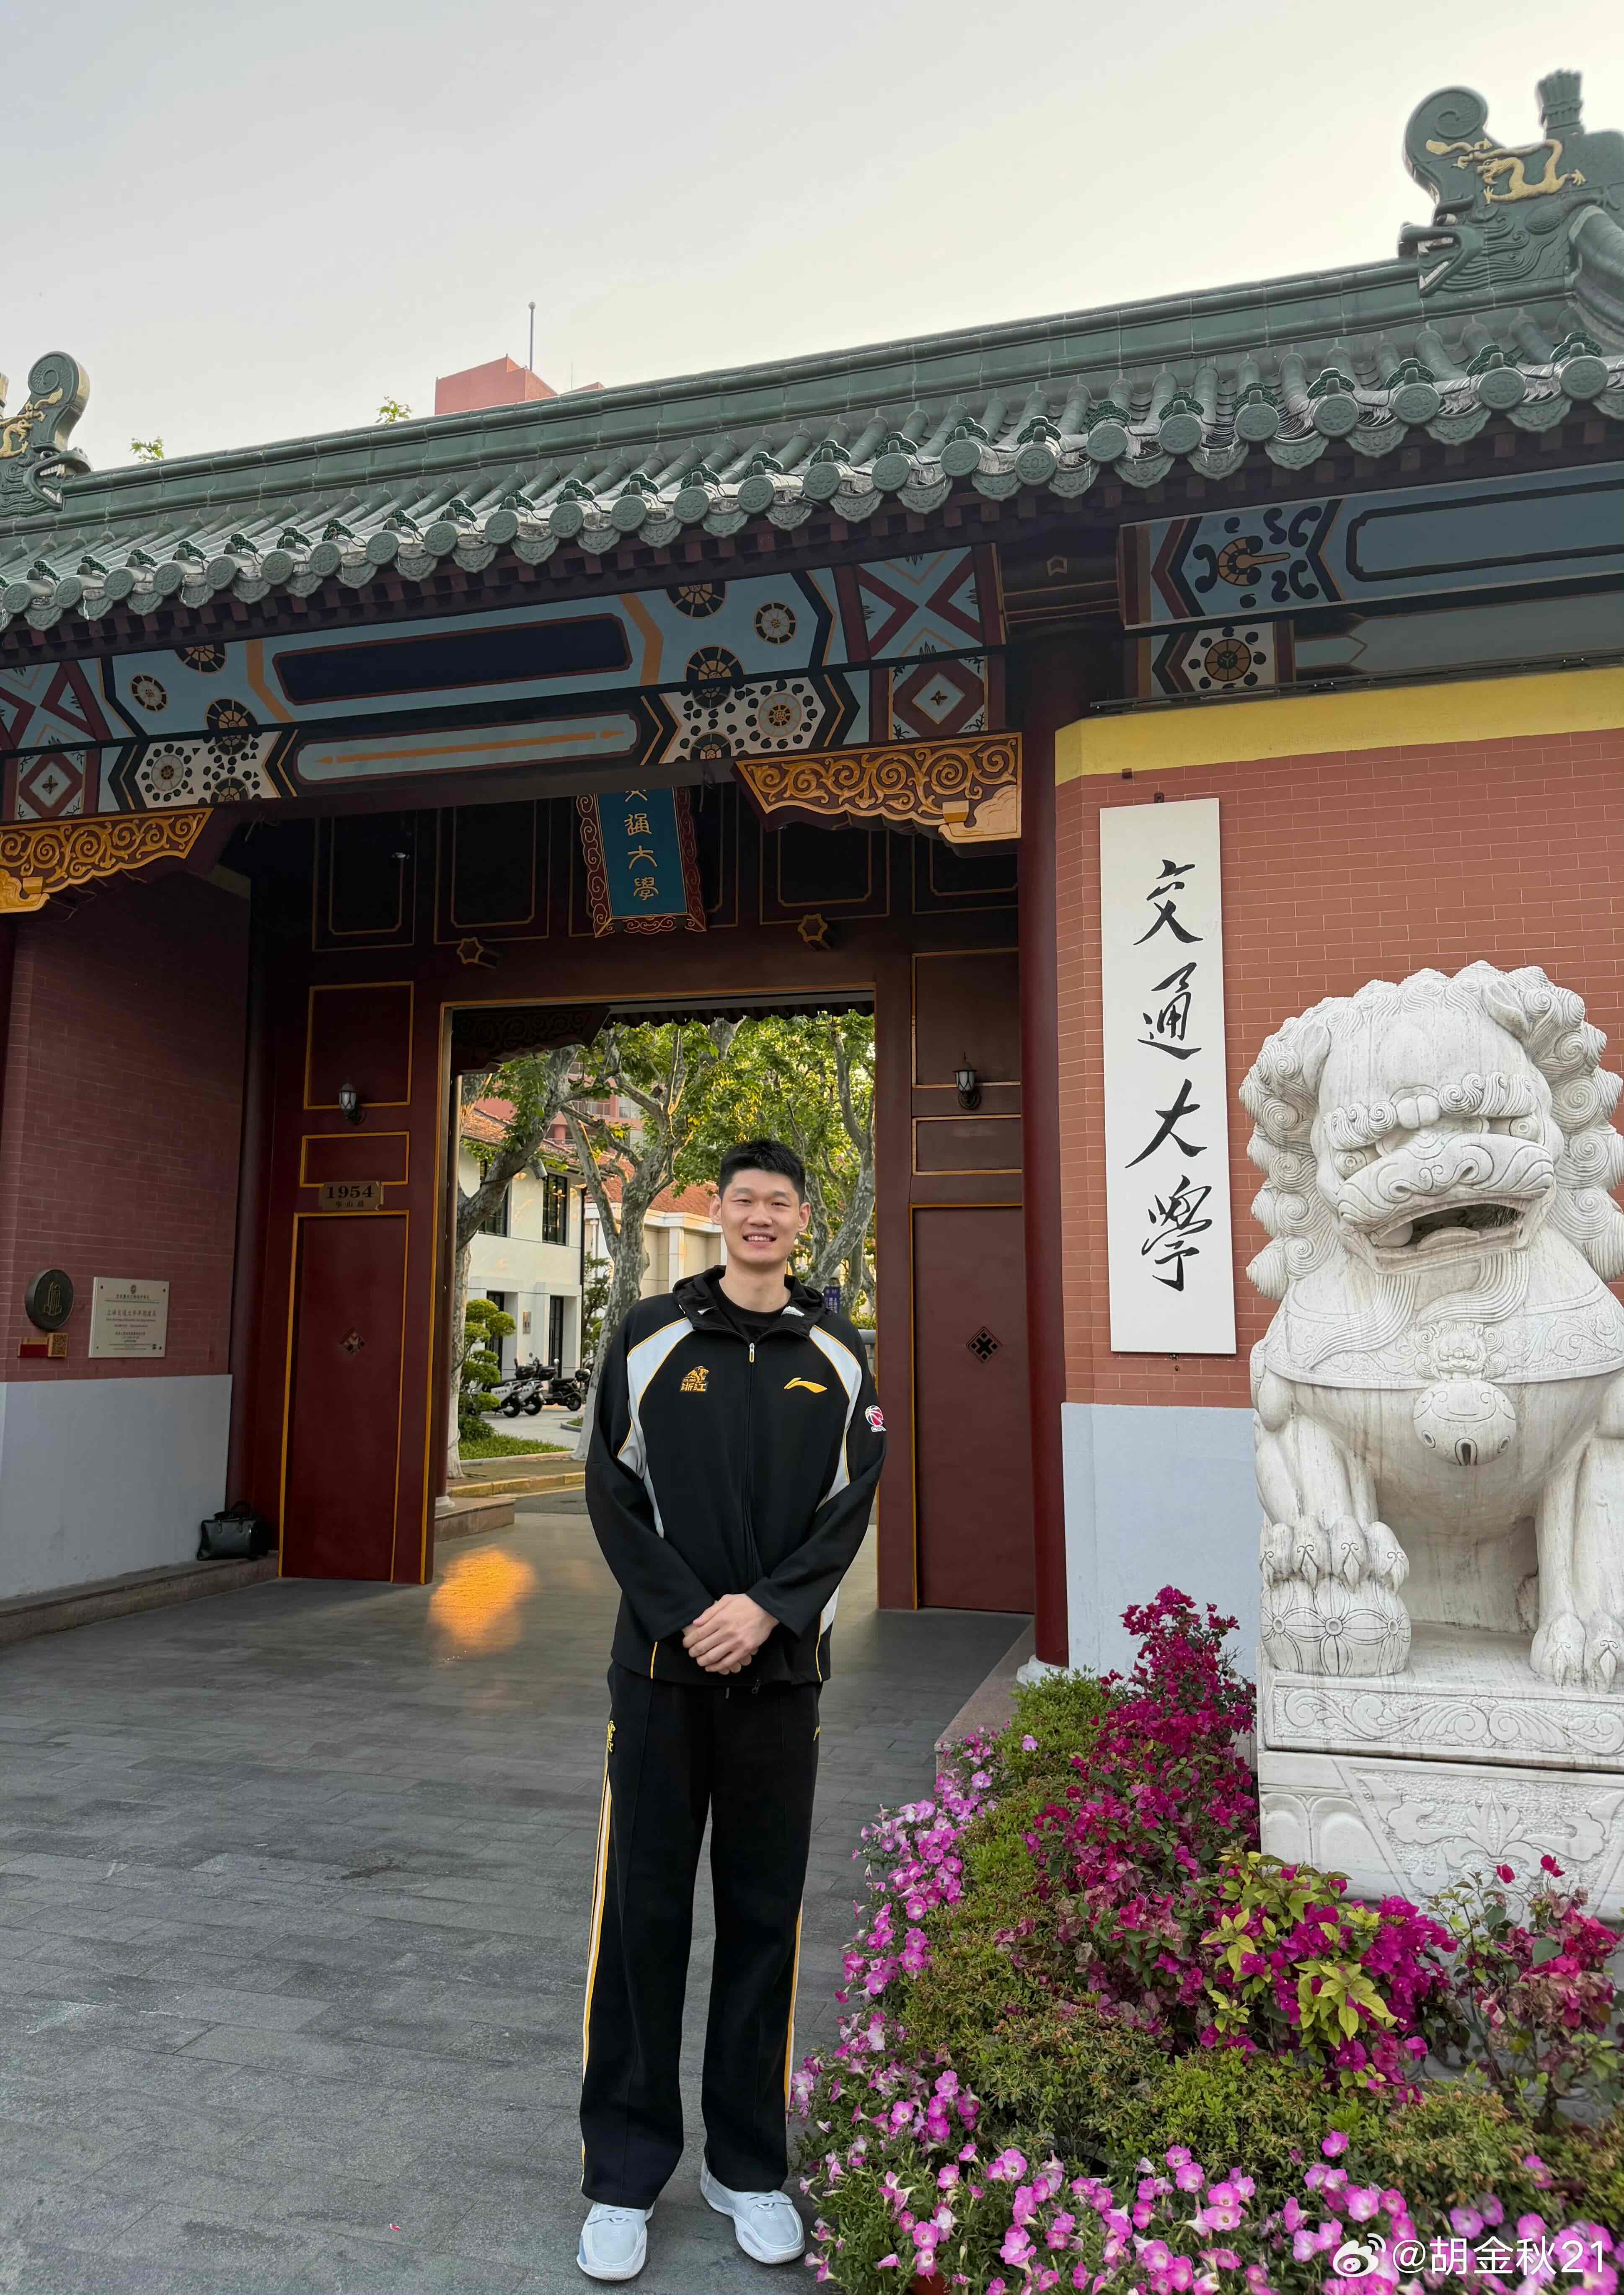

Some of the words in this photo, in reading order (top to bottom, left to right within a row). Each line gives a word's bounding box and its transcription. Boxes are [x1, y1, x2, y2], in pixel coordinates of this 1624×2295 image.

[1125, 859, 1213, 1292] 交通大學
[327, 1185, 374, 1199] 1954
[680, 1383, 707, 1391] 浙江
